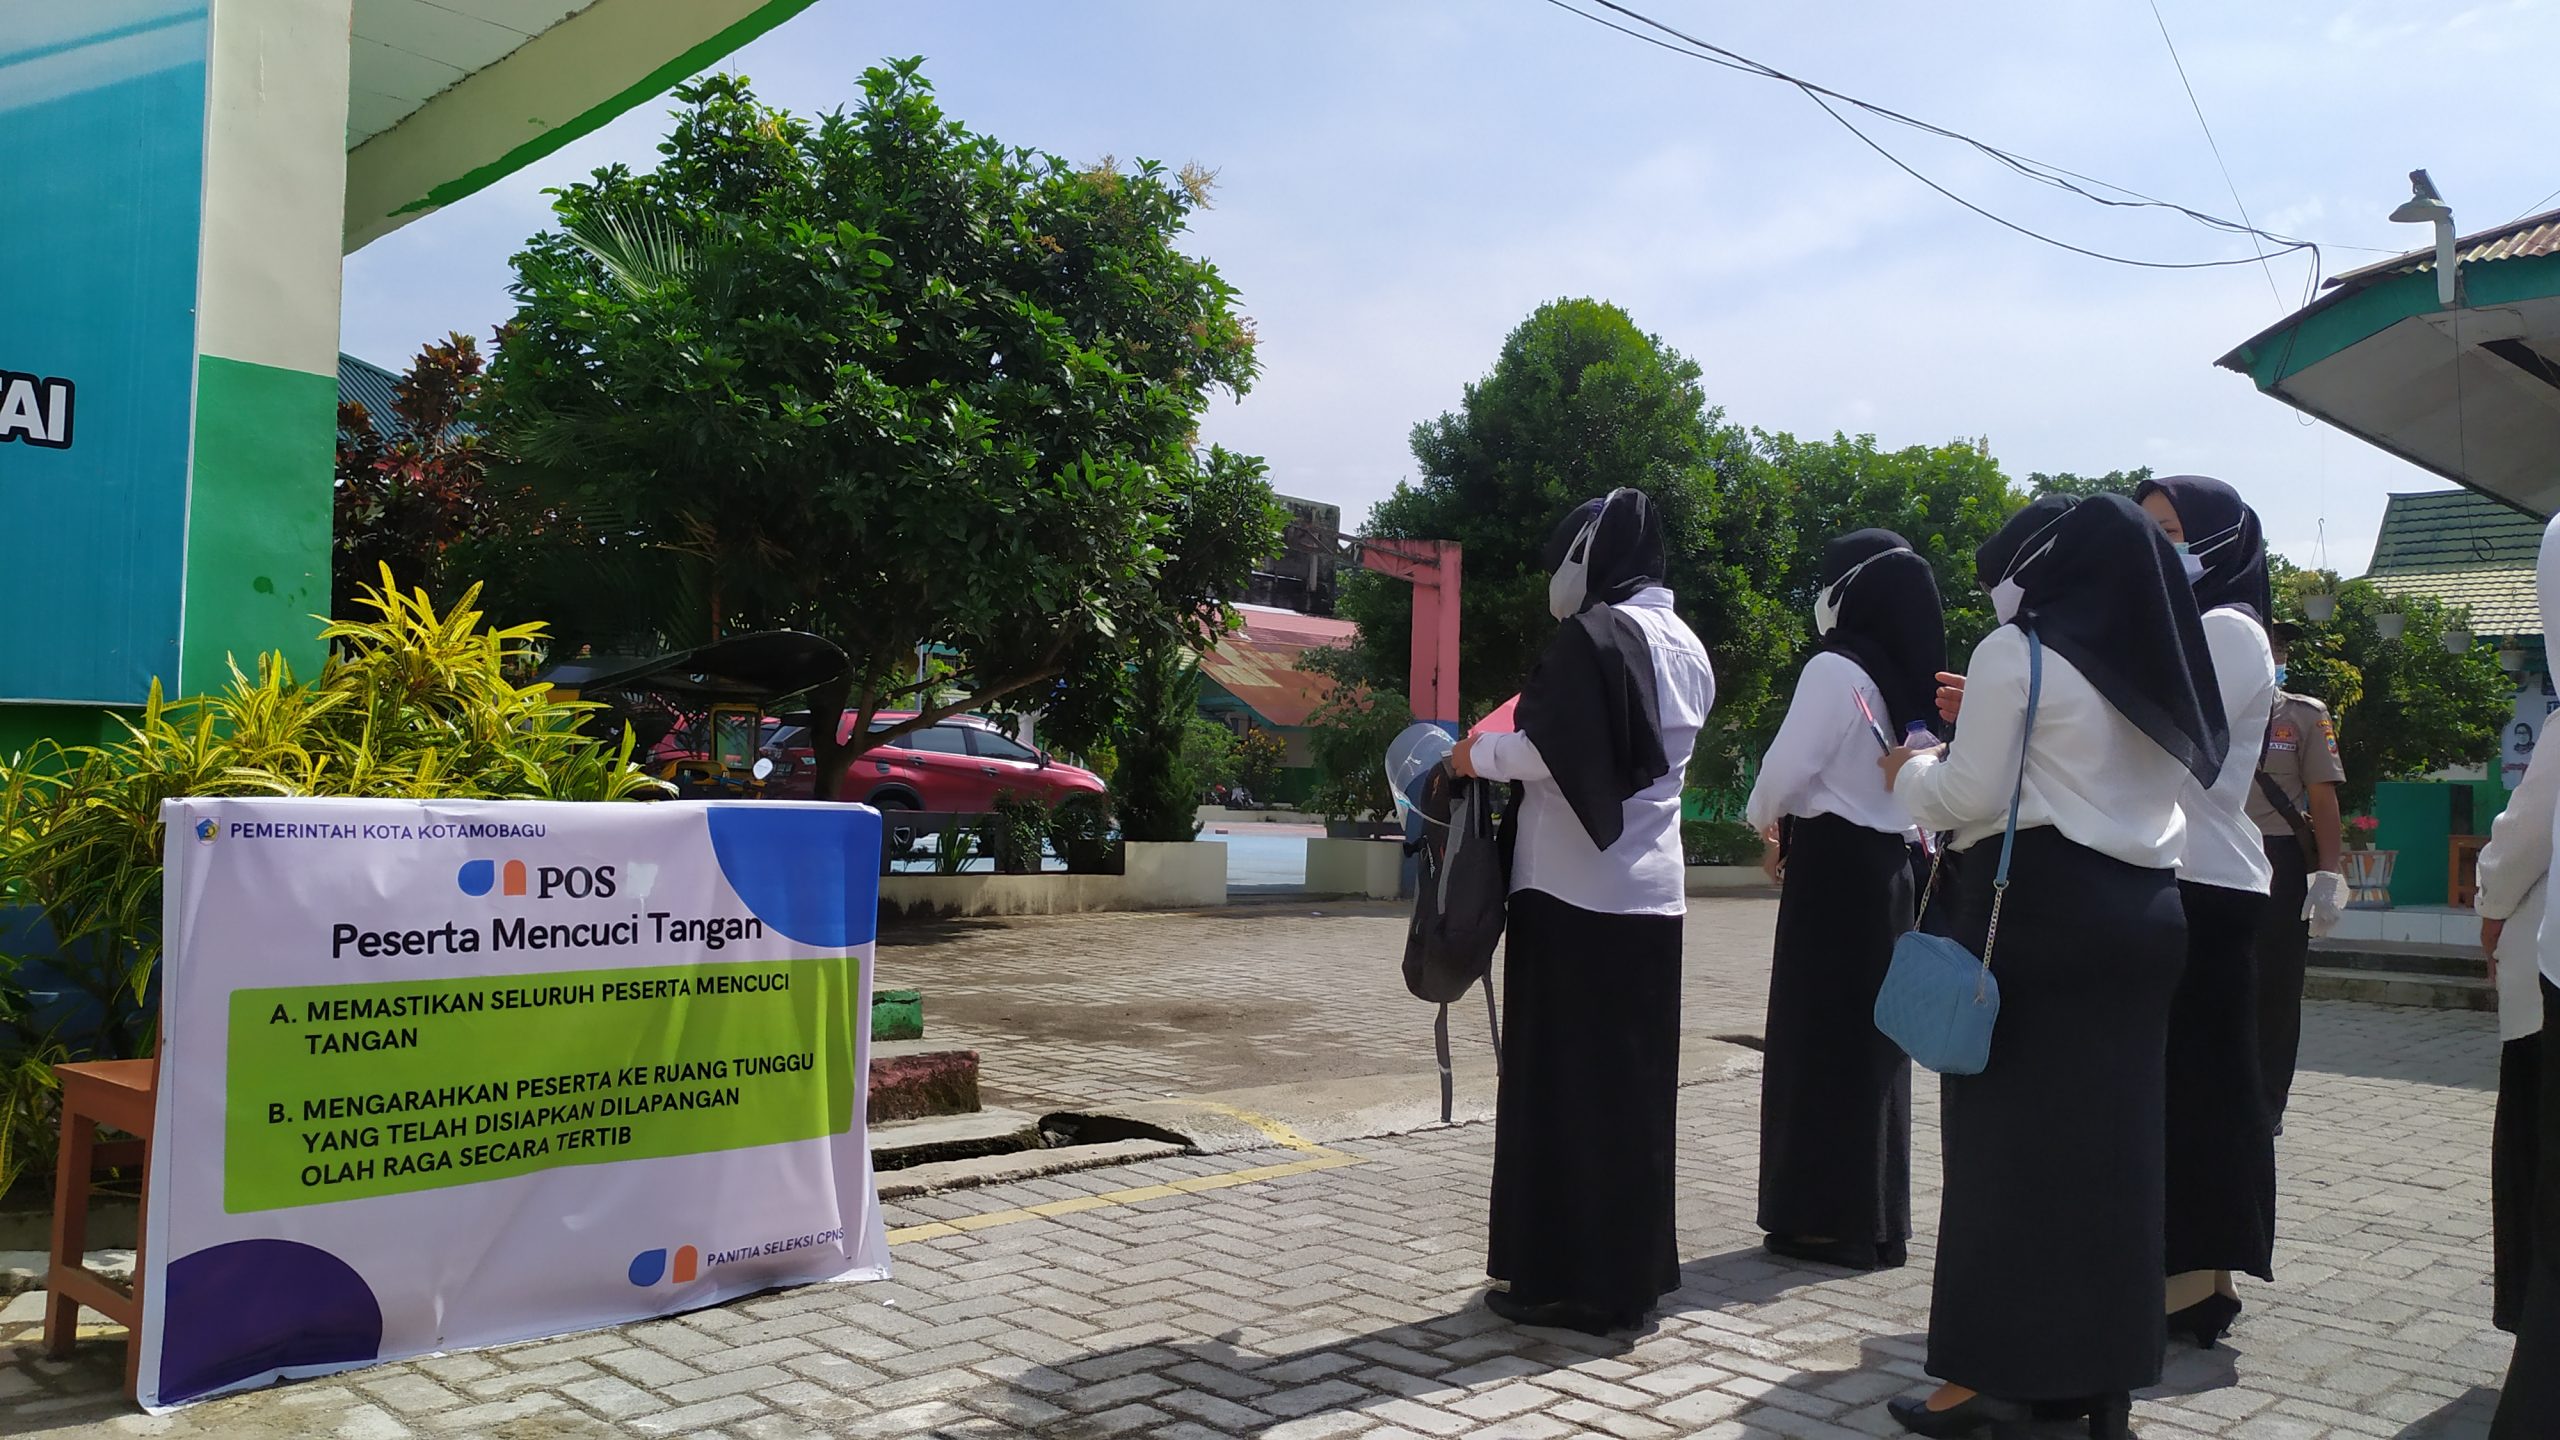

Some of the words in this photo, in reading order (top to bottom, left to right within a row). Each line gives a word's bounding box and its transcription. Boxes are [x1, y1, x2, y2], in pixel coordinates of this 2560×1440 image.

[0, 375, 70, 445] AI
[231, 823, 356, 839] PEMERINTAH
[363, 825, 413, 839] KOTA
[418, 824, 546, 840] KOTAMOBAGU
[537, 865, 616, 899] POS
[332, 921, 479, 959] Peserta
[492, 913, 638, 950] Mencuci
[647, 912, 762, 949] Tangan
[269, 1003, 297, 1024] A.
[307, 992, 484, 1022] MEMASTIKAN
[490, 984, 594, 1009] SELURUH
[602, 978, 690, 1002] PESERTA
[696, 973, 789, 995] MENCUCI
[305, 1028, 418, 1055] TANGAN
[268, 1103, 293, 1124] B.
[303, 1082, 508, 1121] MENGARAHKAN
[516, 1071, 611, 1100] PESERTA
[617, 1066, 648, 1087] KE
[653, 1060, 727, 1084] RUANG
[733, 1053, 814, 1077] TUNGGU
[302, 1126, 379, 1153] YANG
[387, 1116, 467, 1146] TELAH
[475, 1101, 594, 1135] DISIAPKAN
[600, 1087, 740, 1117] DILAPANGAN
[301, 1159, 374, 1187] OLAH
[383, 1150, 452, 1178] RAGA
[459, 1136, 550, 1168] SECARA
[556, 1126, 632, 1152] TERTIB
[707, 1244, 760, 1267] PANITIA
[763, 1234, 813, 1255] SELEKSI
[816, 1226, 845, 1246] CPNS
